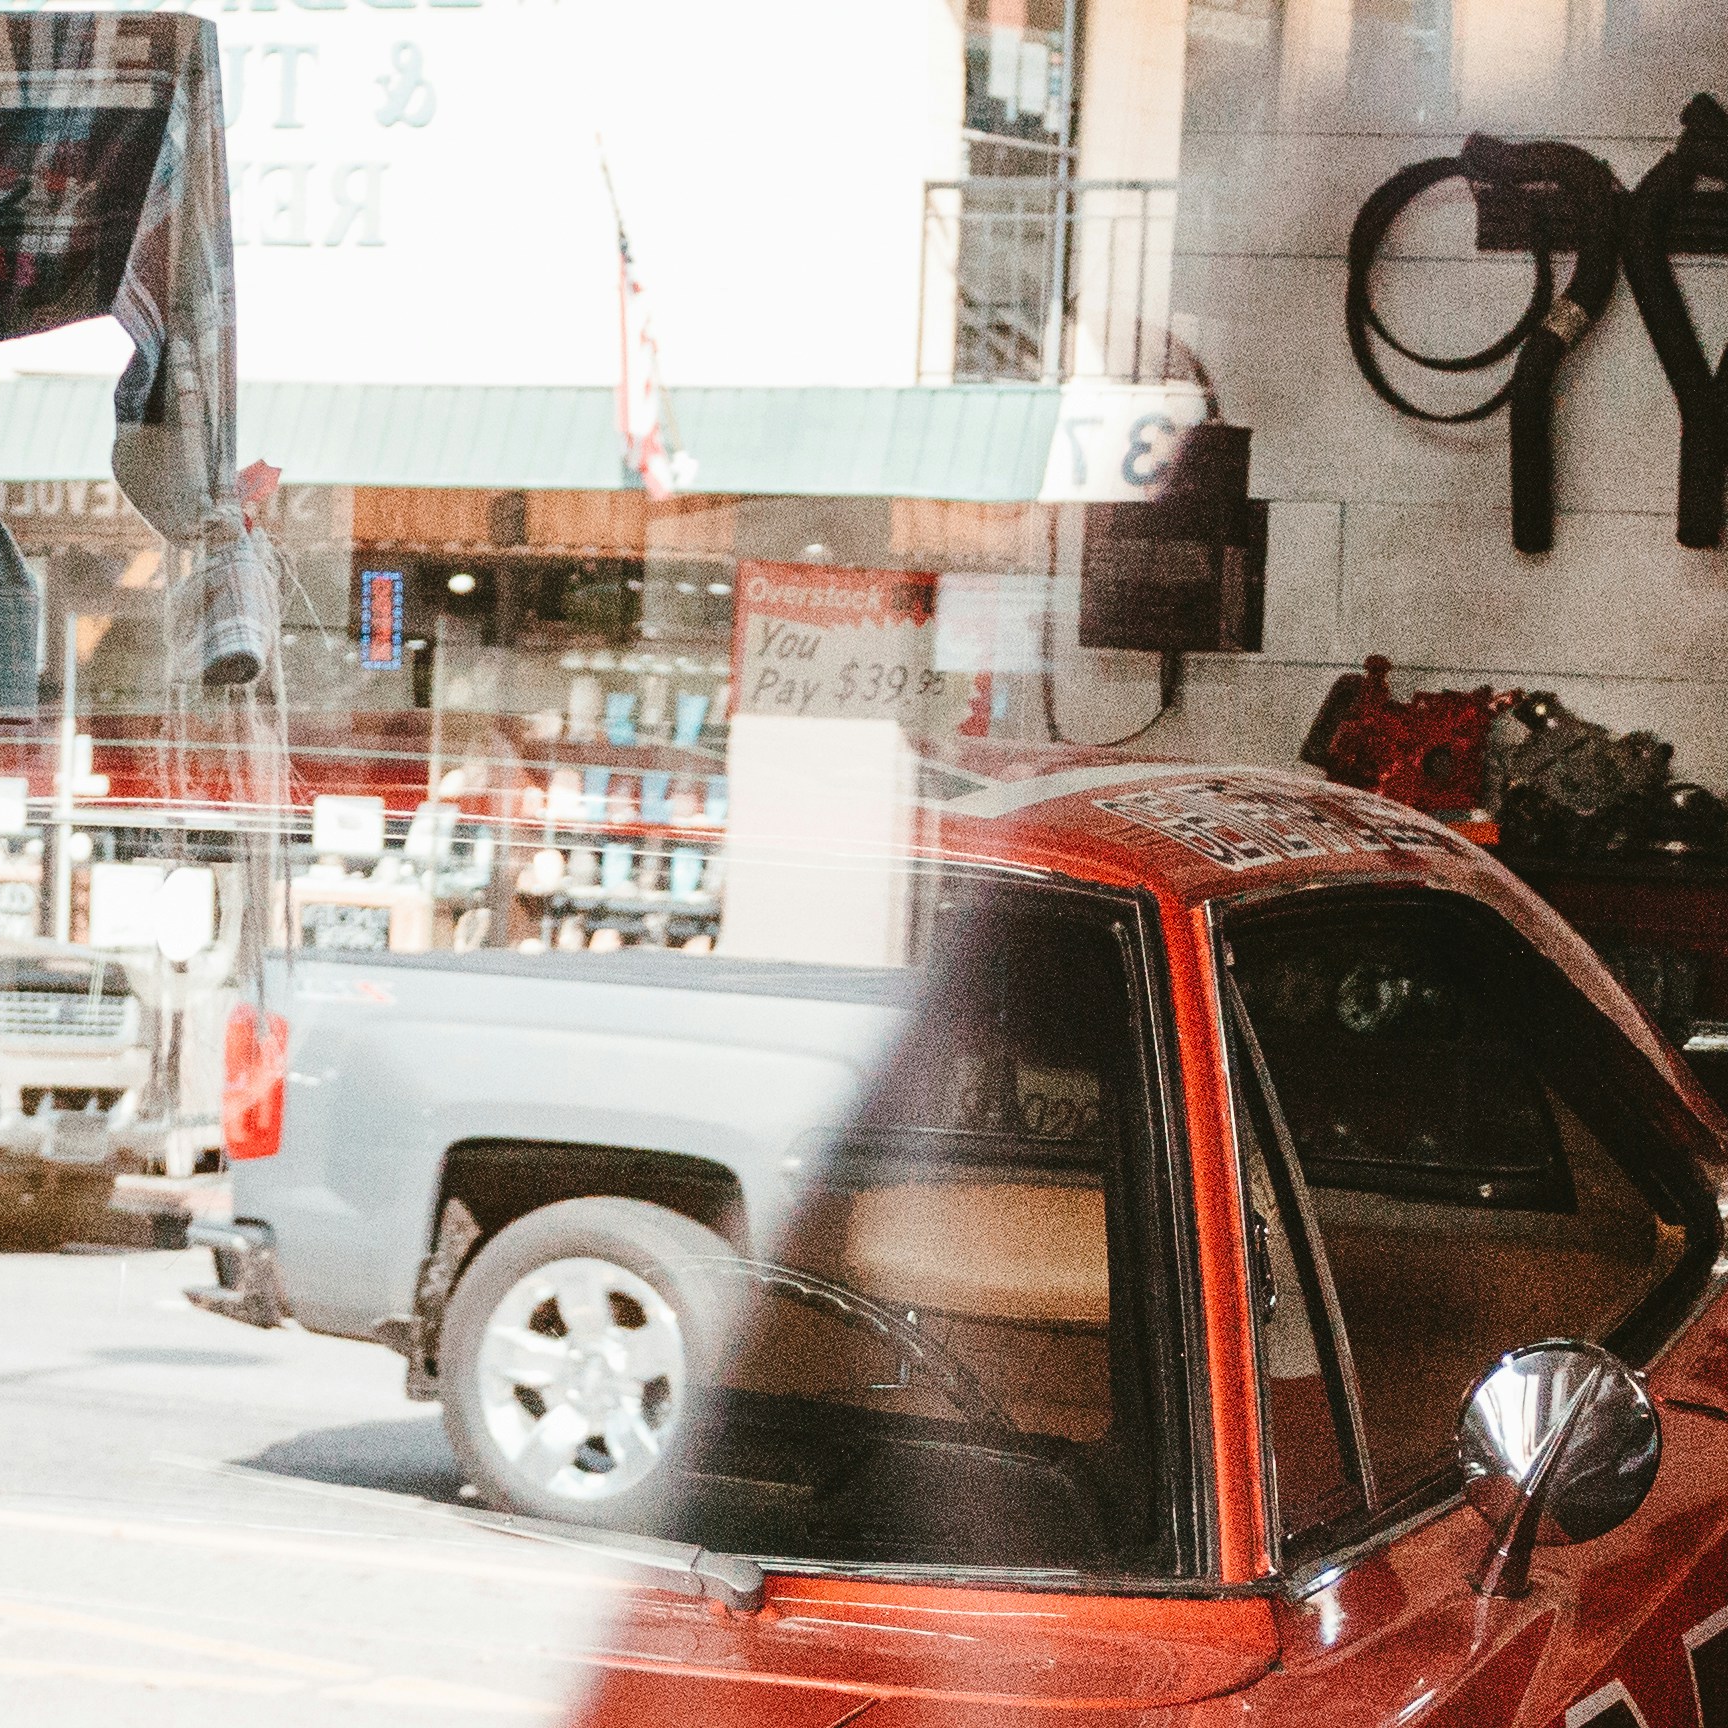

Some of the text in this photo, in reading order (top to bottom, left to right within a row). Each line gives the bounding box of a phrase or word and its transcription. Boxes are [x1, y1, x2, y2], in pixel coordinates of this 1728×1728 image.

[746, 576, 883, 612] Overstock
[757, 619, 821, 661] You
[752, 667, 821, 713] Pay
